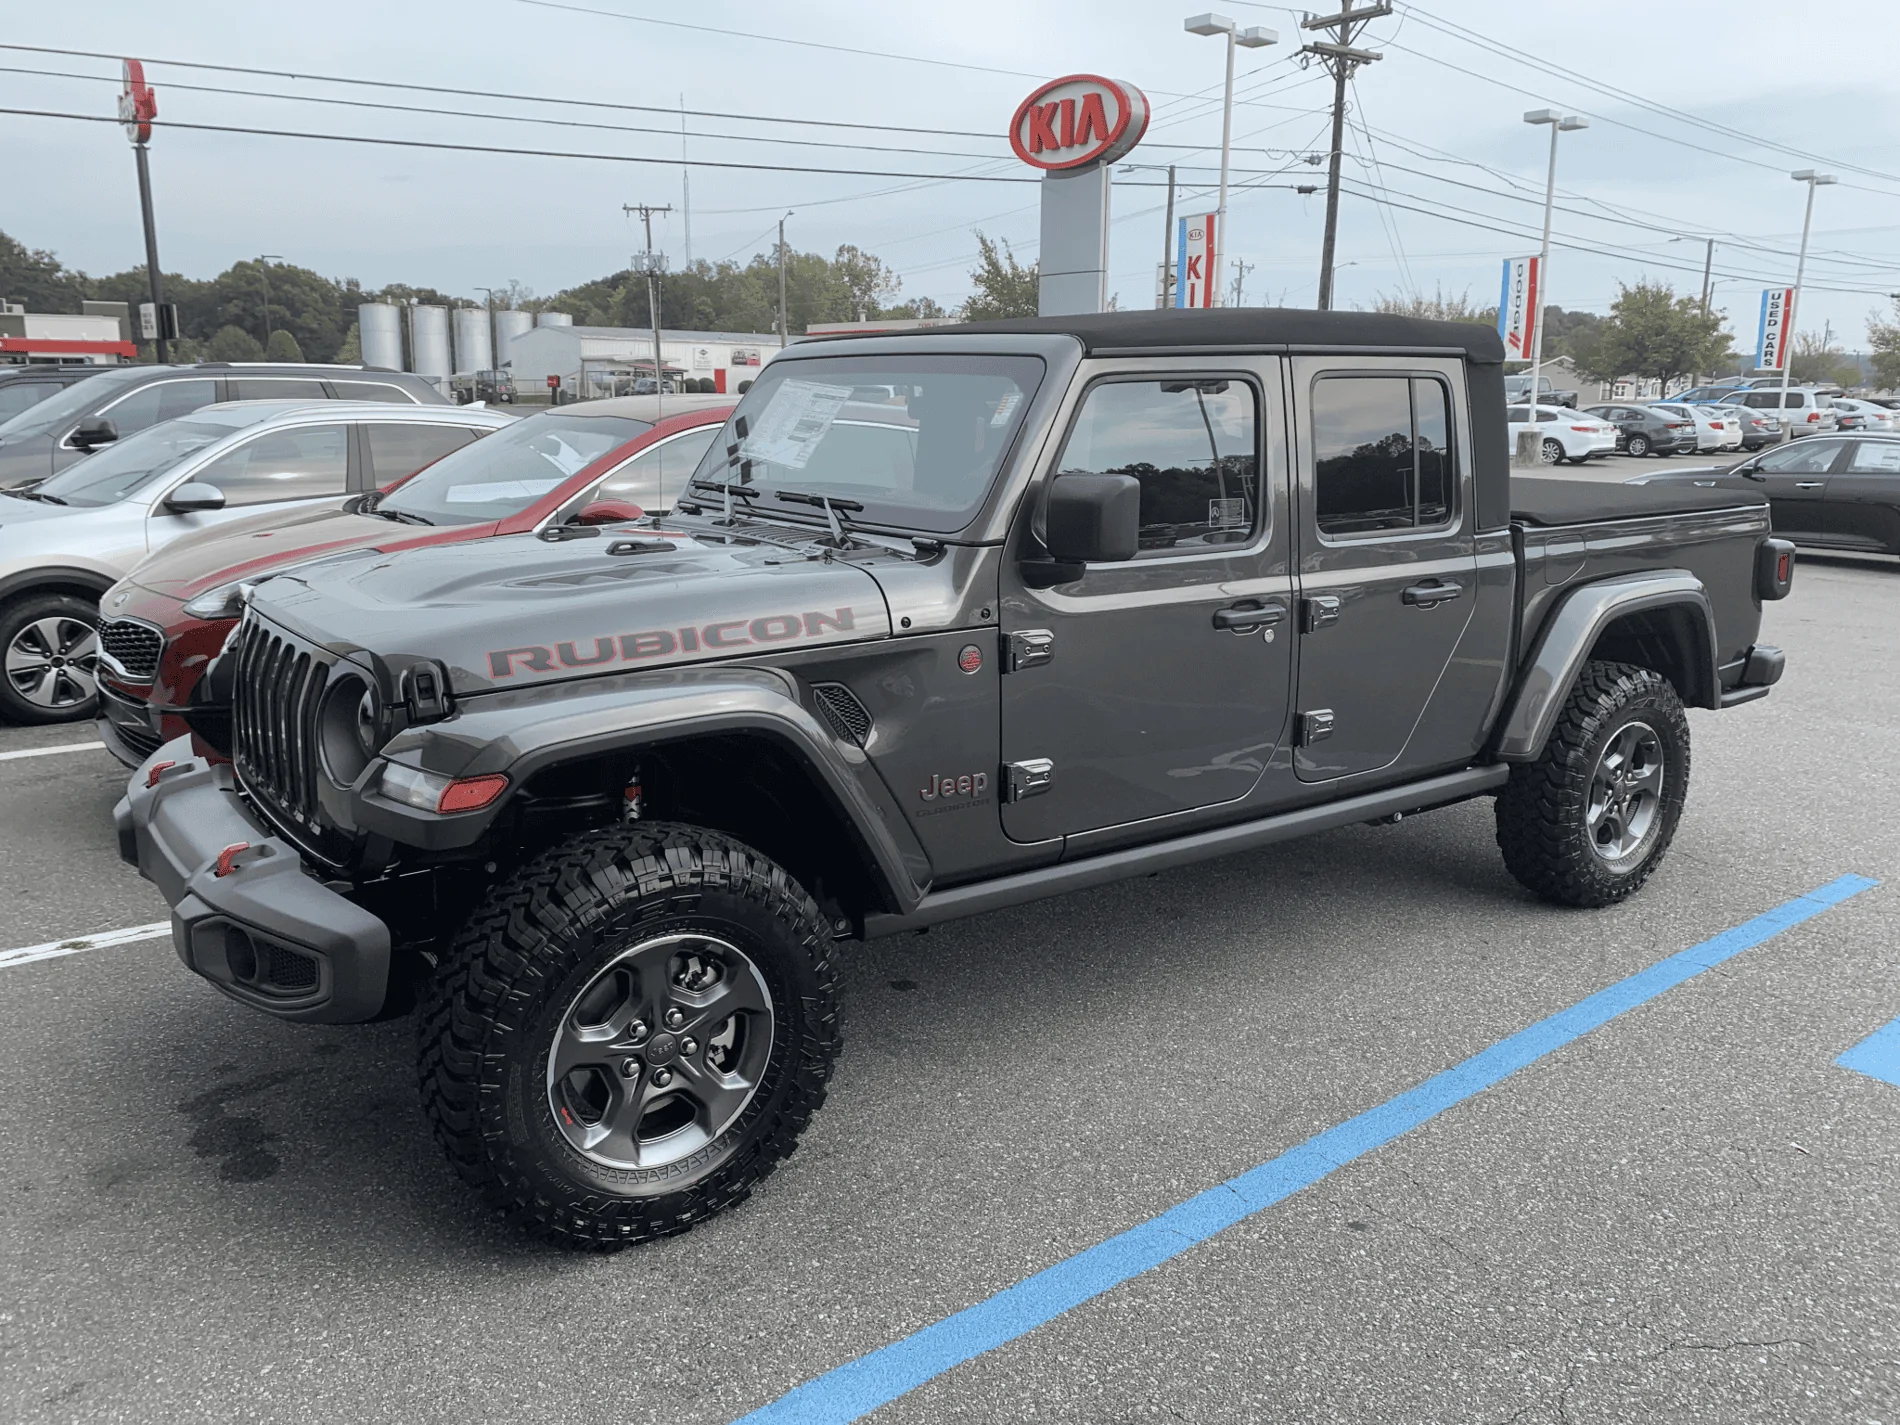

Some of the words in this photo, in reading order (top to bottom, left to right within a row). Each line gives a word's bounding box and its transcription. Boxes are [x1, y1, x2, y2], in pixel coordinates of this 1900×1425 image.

[1028, 92, 1110, 153] KIA
[1189, 231, 1203, 239] KIA
[1186, 255, 1202, 307] KI
[1767, 293, 1782, 327] USED
[1763, 333, 1776, 366] CARS
[485, 607, 855, 679] RUBICON
[920, 772, 988, 802] Jeep
[915, 798, 990, 818] GLADIATOR
